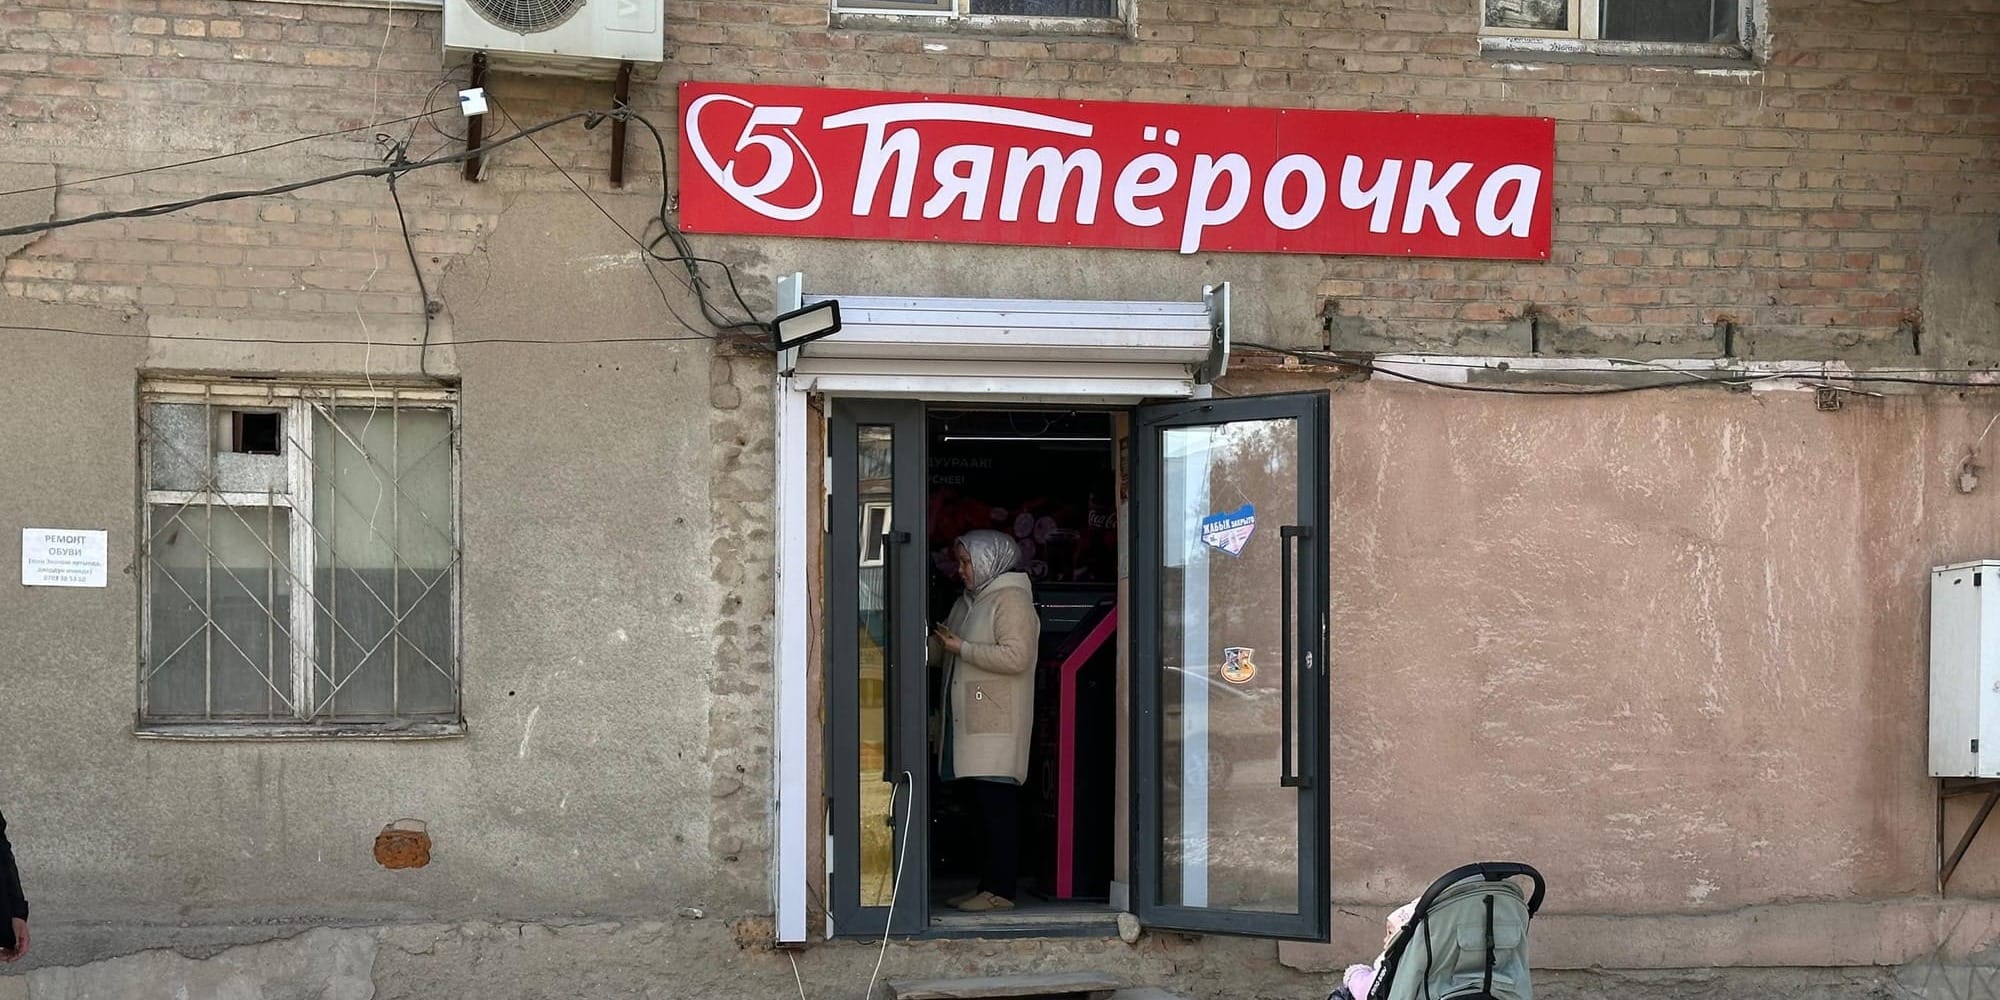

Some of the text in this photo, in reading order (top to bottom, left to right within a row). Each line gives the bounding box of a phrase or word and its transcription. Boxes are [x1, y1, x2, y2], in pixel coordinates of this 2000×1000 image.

[723, 102, 1542, 254] 5 Пятёрочка
[1203, 519, 1231, 534] ЖАБЫК
[45, 535, 87, 544] РЕМОНТ
[48, 547, 82, 557] ОБУВИ
